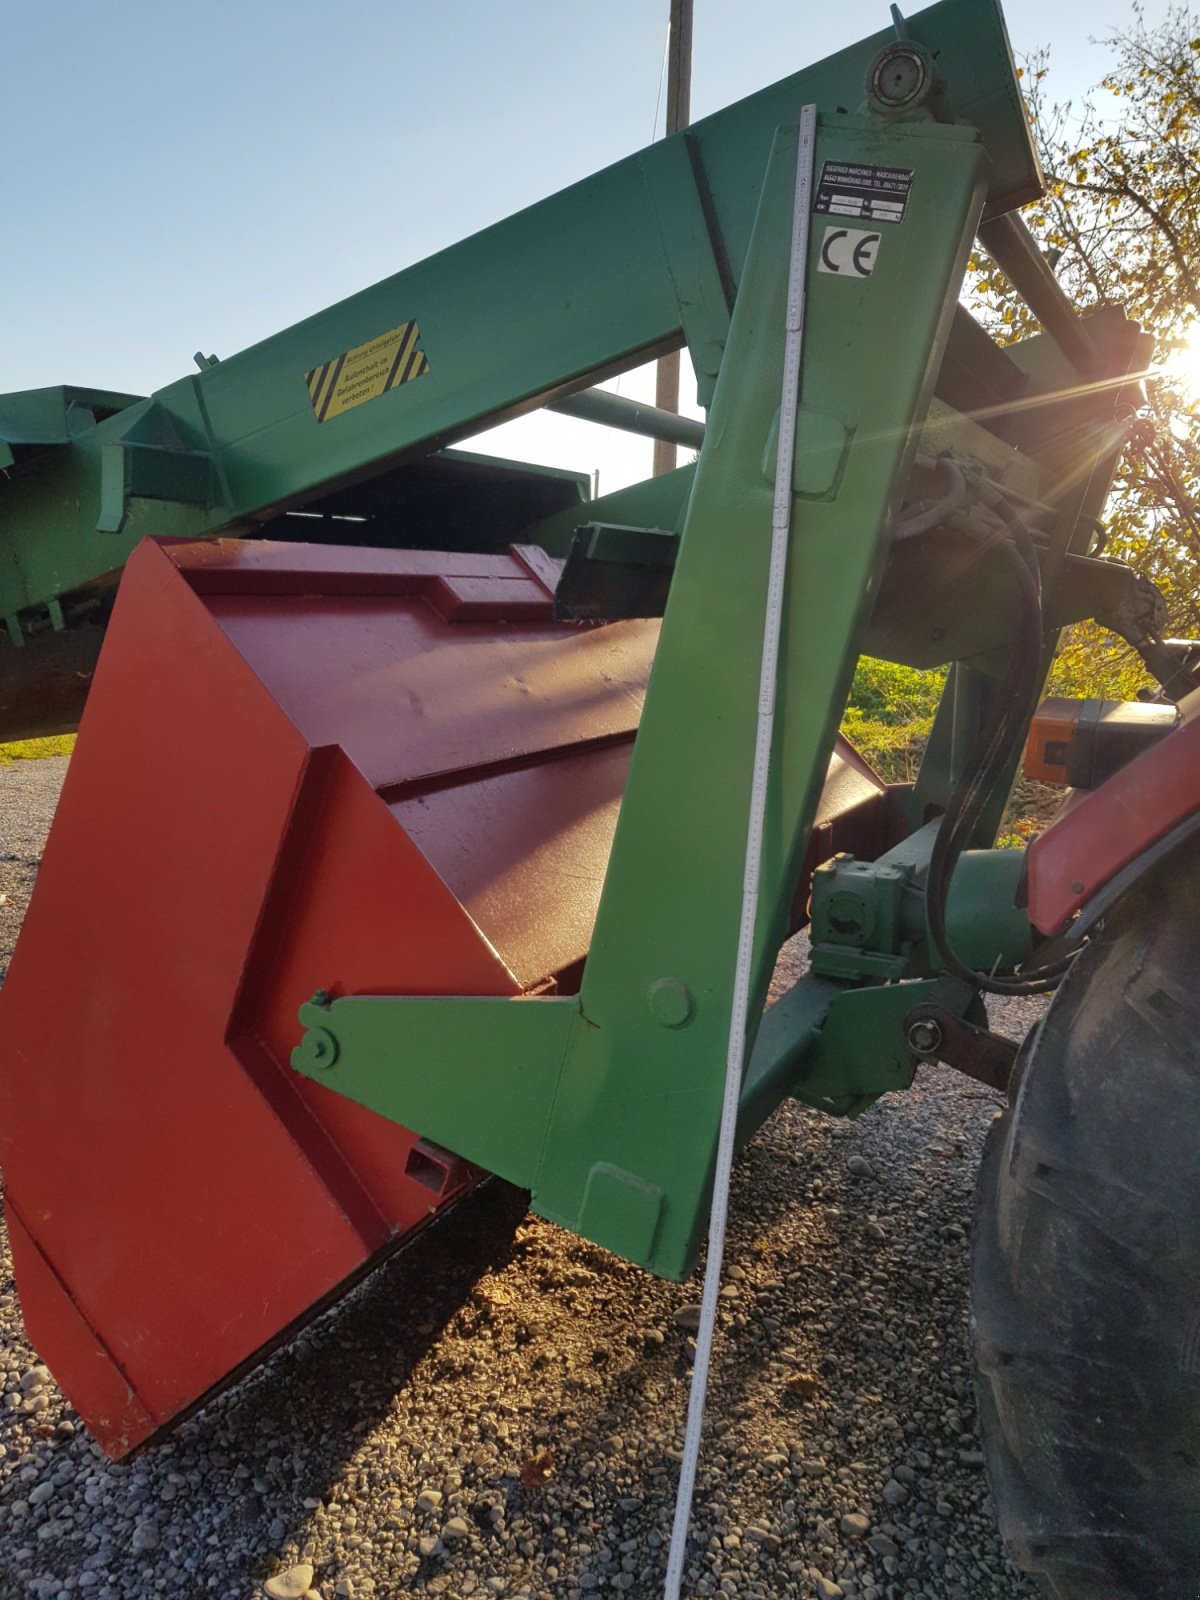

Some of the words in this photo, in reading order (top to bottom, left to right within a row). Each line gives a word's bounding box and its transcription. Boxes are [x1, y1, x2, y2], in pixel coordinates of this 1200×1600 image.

[822, 230, 880, 276] CE
[347, 350, 368, 363] Achtung
[336, 367, 390, 397] Gefahrenbereich
[344, 362, 379, 382] Aufenthalt
[380, 357, 388, 366] im
[342, 388, 370, 405] verboten
